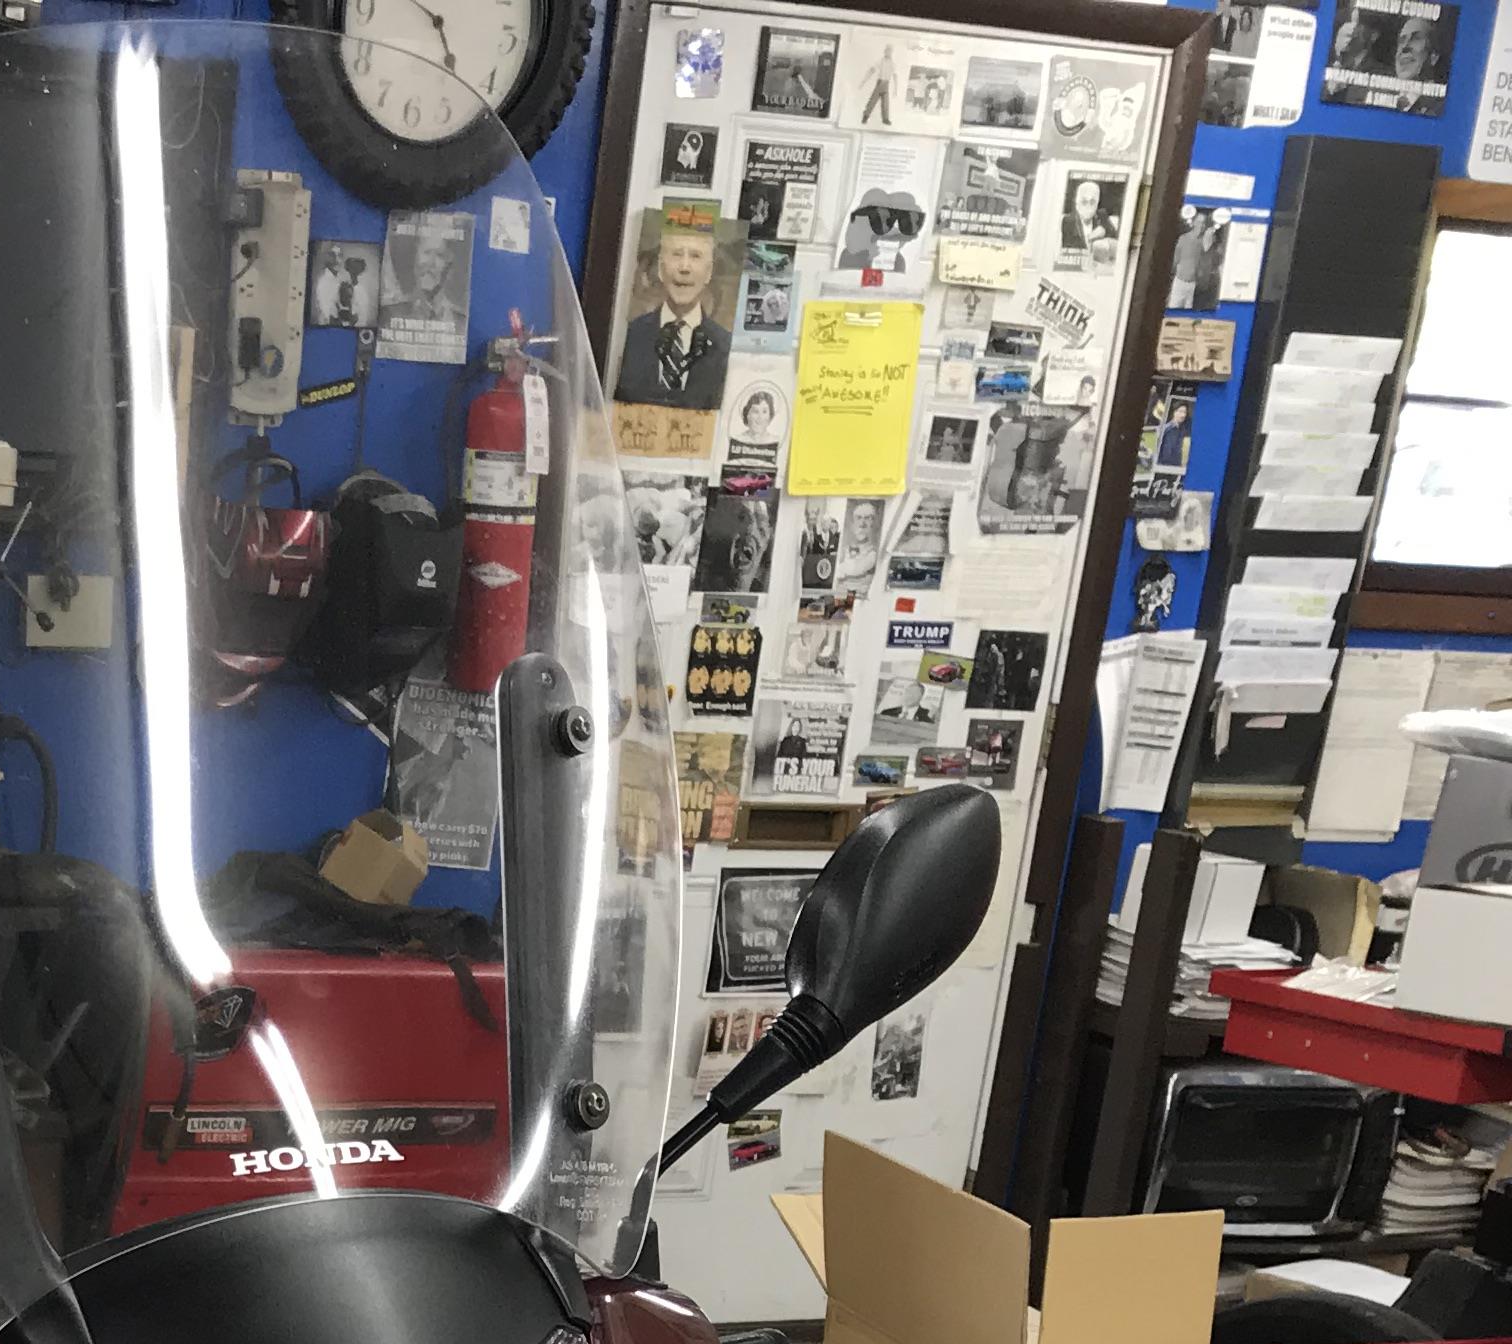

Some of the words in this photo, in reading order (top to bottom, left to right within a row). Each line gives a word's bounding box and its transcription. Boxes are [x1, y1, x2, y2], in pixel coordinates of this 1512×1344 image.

[402, 97, 421, 128] 6
[764, 146, 814, 163] ASKHOLE
[1038, 284, 1091, 329] THINK
[893, 625, 950, 638] TRUMP
[409, 684, 496, 709] BIDENOMIC
[775, 757, 800, 776] IT'S
[801, 758, 836, 776] YOUR
[772, 775, 822, 793] FUNERAL
[741, 887, 801, 902] WELCOME
[740, 928, 779, 948] NEW
[190, 1117, 246, 1132] LINCOLN
[373, 1115, 418, 1133] MIG
[201, 1132, 248, 1144] ELECTRIC
[229, 1139, 405, 1177] HONDA
